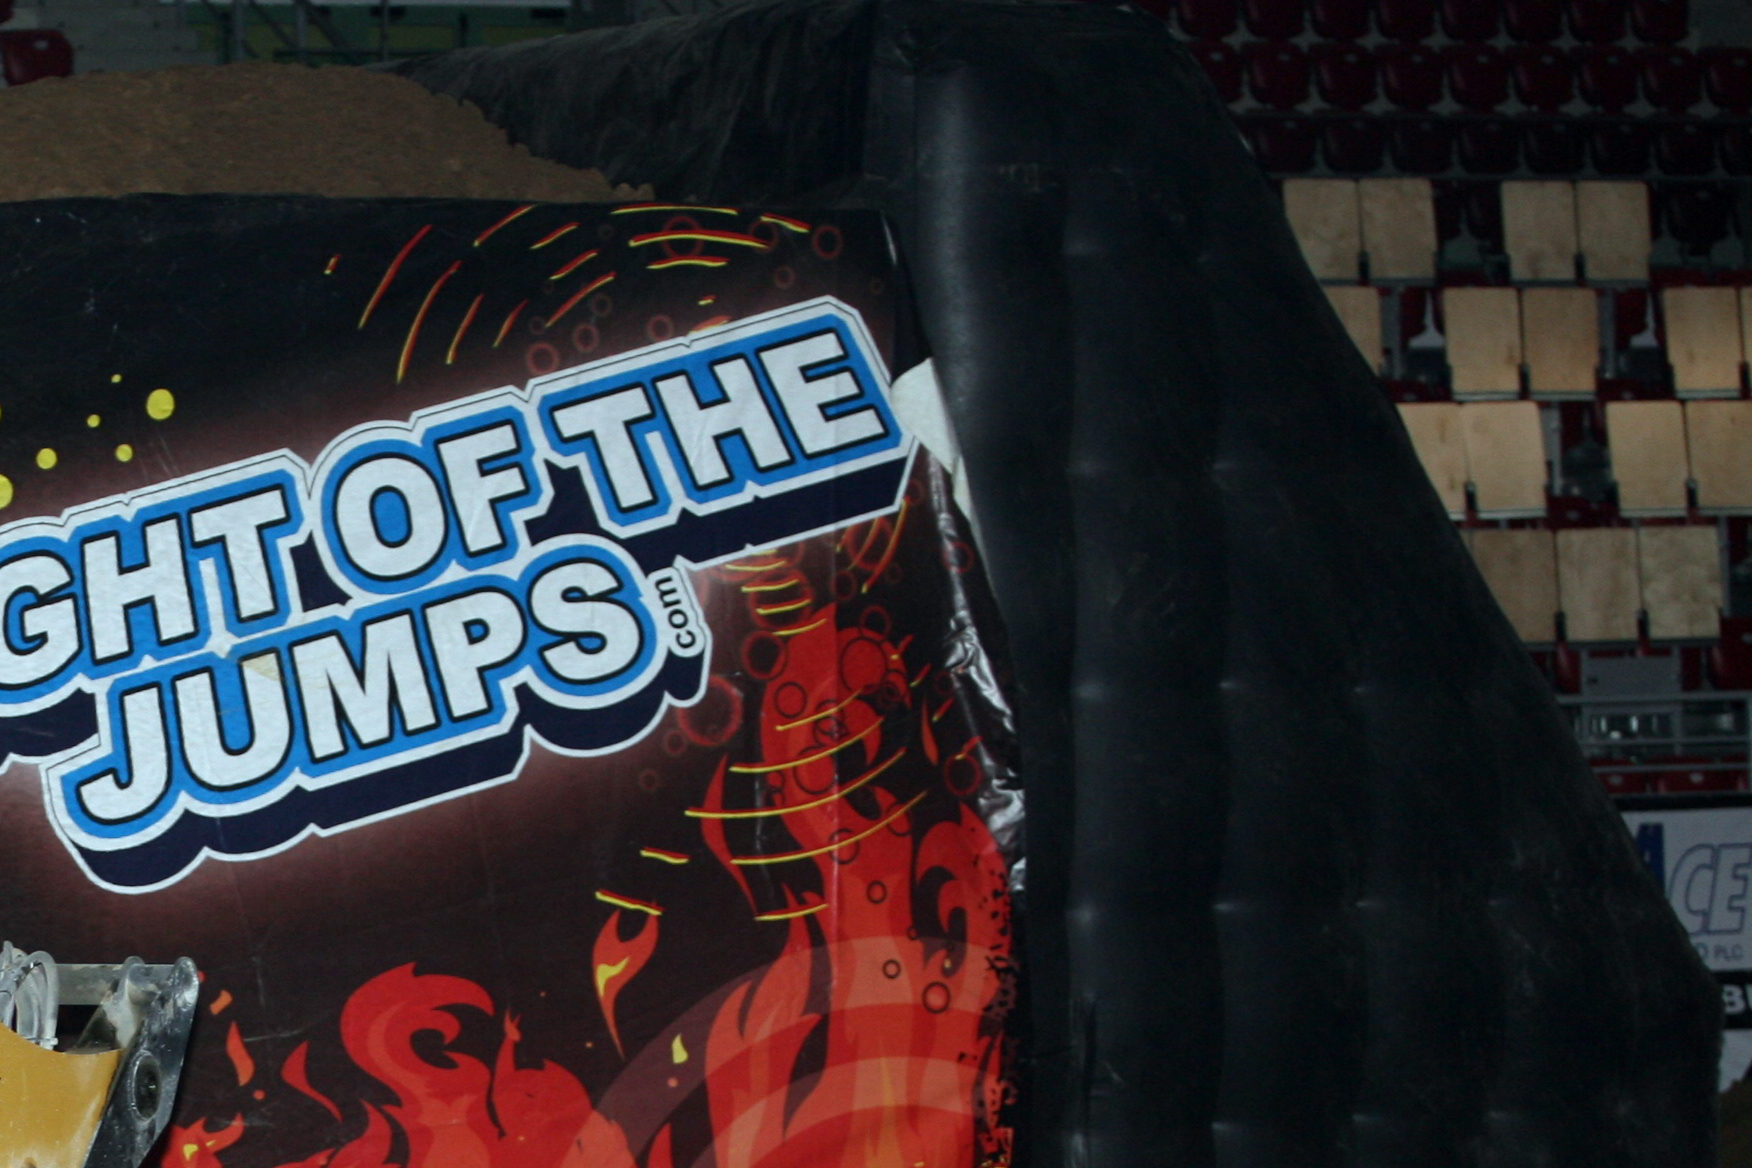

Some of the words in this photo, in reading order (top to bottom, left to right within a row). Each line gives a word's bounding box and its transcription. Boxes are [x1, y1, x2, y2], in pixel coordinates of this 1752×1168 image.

[333, 420, 533, 587] OF
[547, 328, 889, 519] THE
[75, 554, 646, 828] JUMPS
